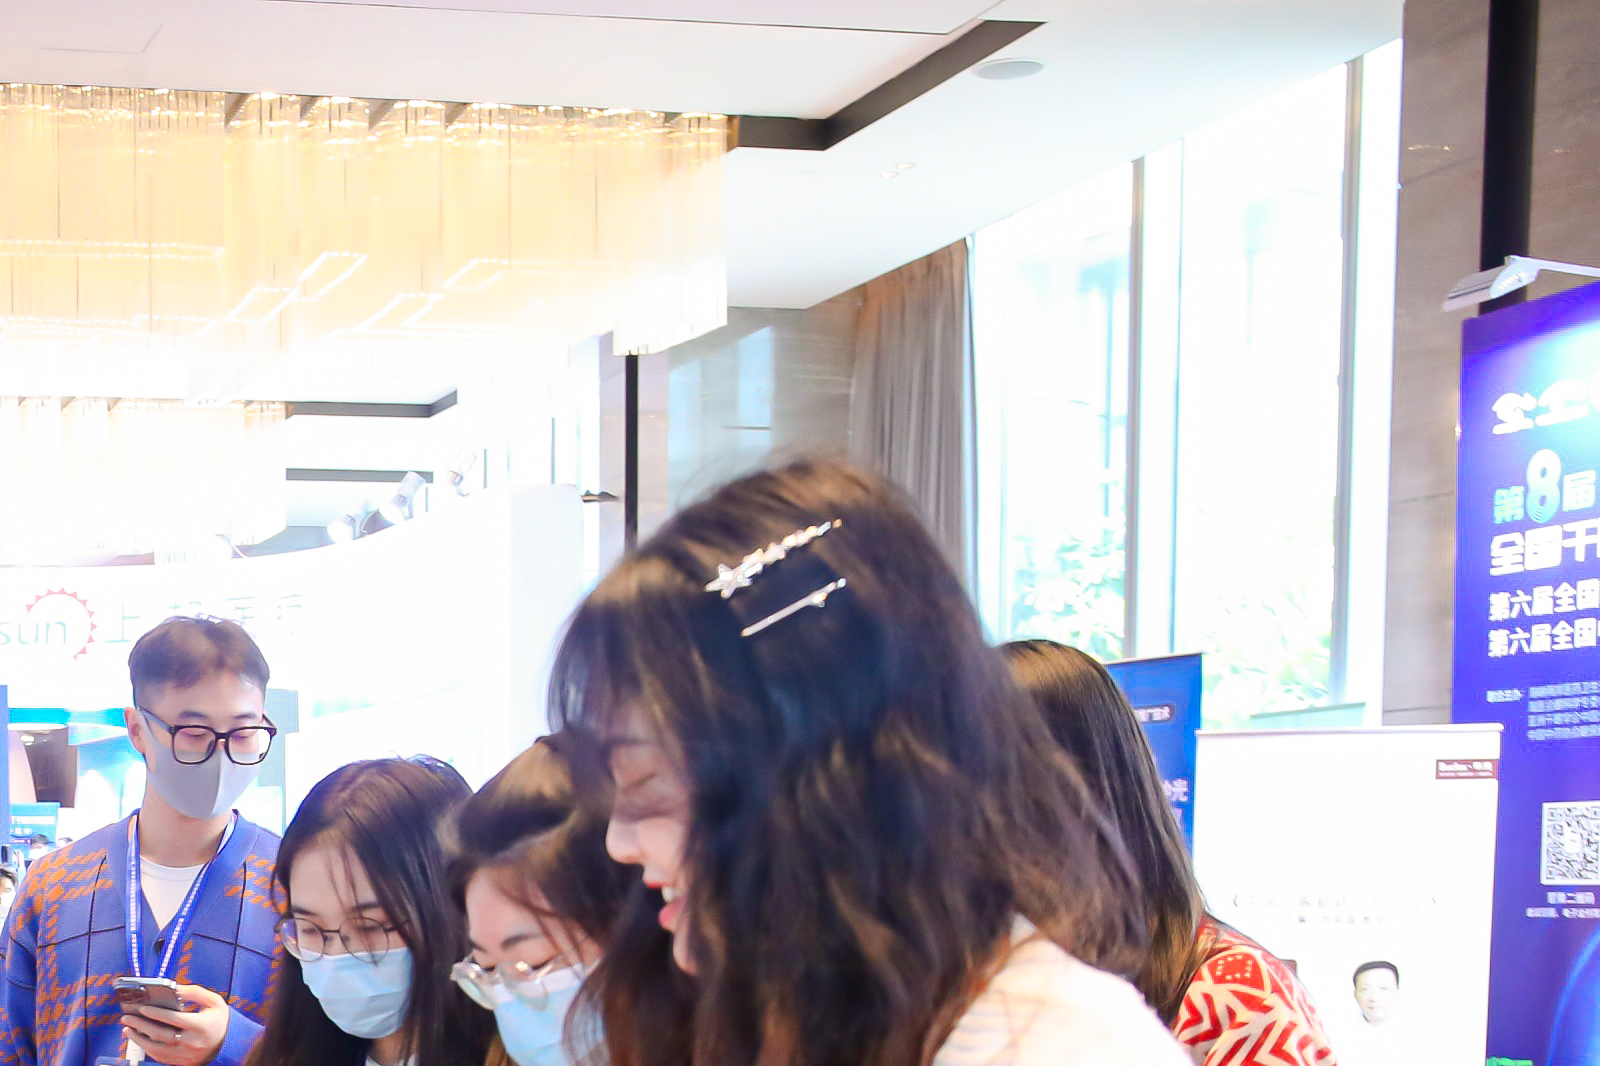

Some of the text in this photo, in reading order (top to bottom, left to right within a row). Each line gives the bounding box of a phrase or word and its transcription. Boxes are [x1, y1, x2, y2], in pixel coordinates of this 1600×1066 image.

[1493, 449, 1597, 524] 第8届
[1490, 518, 1600, 577] 全国干
[1488, 578, 1600, 622] 第六届全国
[1487, 617, 1600, 658] 第六届全国
